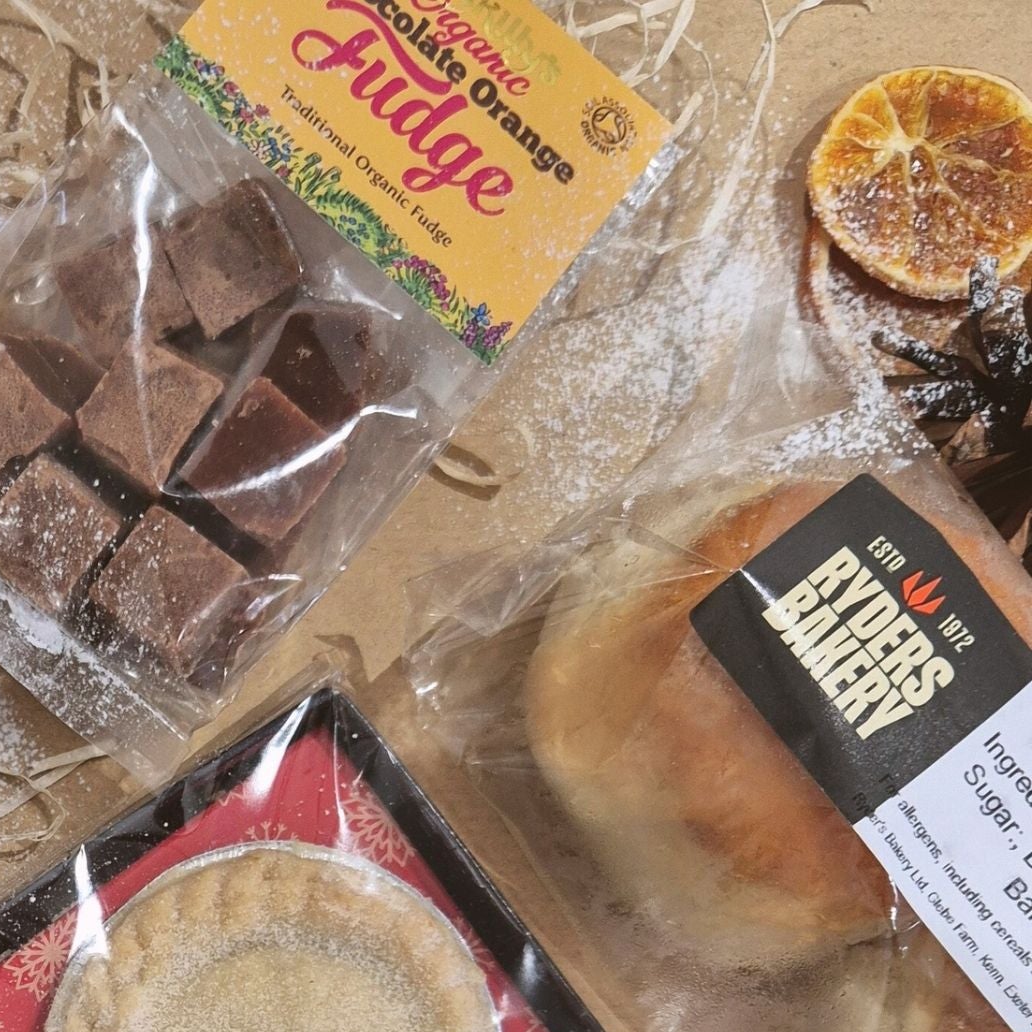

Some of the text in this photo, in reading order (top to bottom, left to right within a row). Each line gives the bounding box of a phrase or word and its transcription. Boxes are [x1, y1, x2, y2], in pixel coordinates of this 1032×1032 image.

[280, 84, 453, 249] Traditional Organic Fudge
[292, 0, 514, 216] Fudge
[365, 0, 467, 85] colate
[469, 77, 575, 186] Orange
[806, 545, 955, 707] RYDERS
[866, 535, 907, 574] ESTD
[761, 578, 915, 741] BAKERY
[884, 832, 914, 872] Bakery
[897, 799, 943, 865] allergens,
[942, 861, 993, 922] including
[990, 920, 1032, 967] cereals
